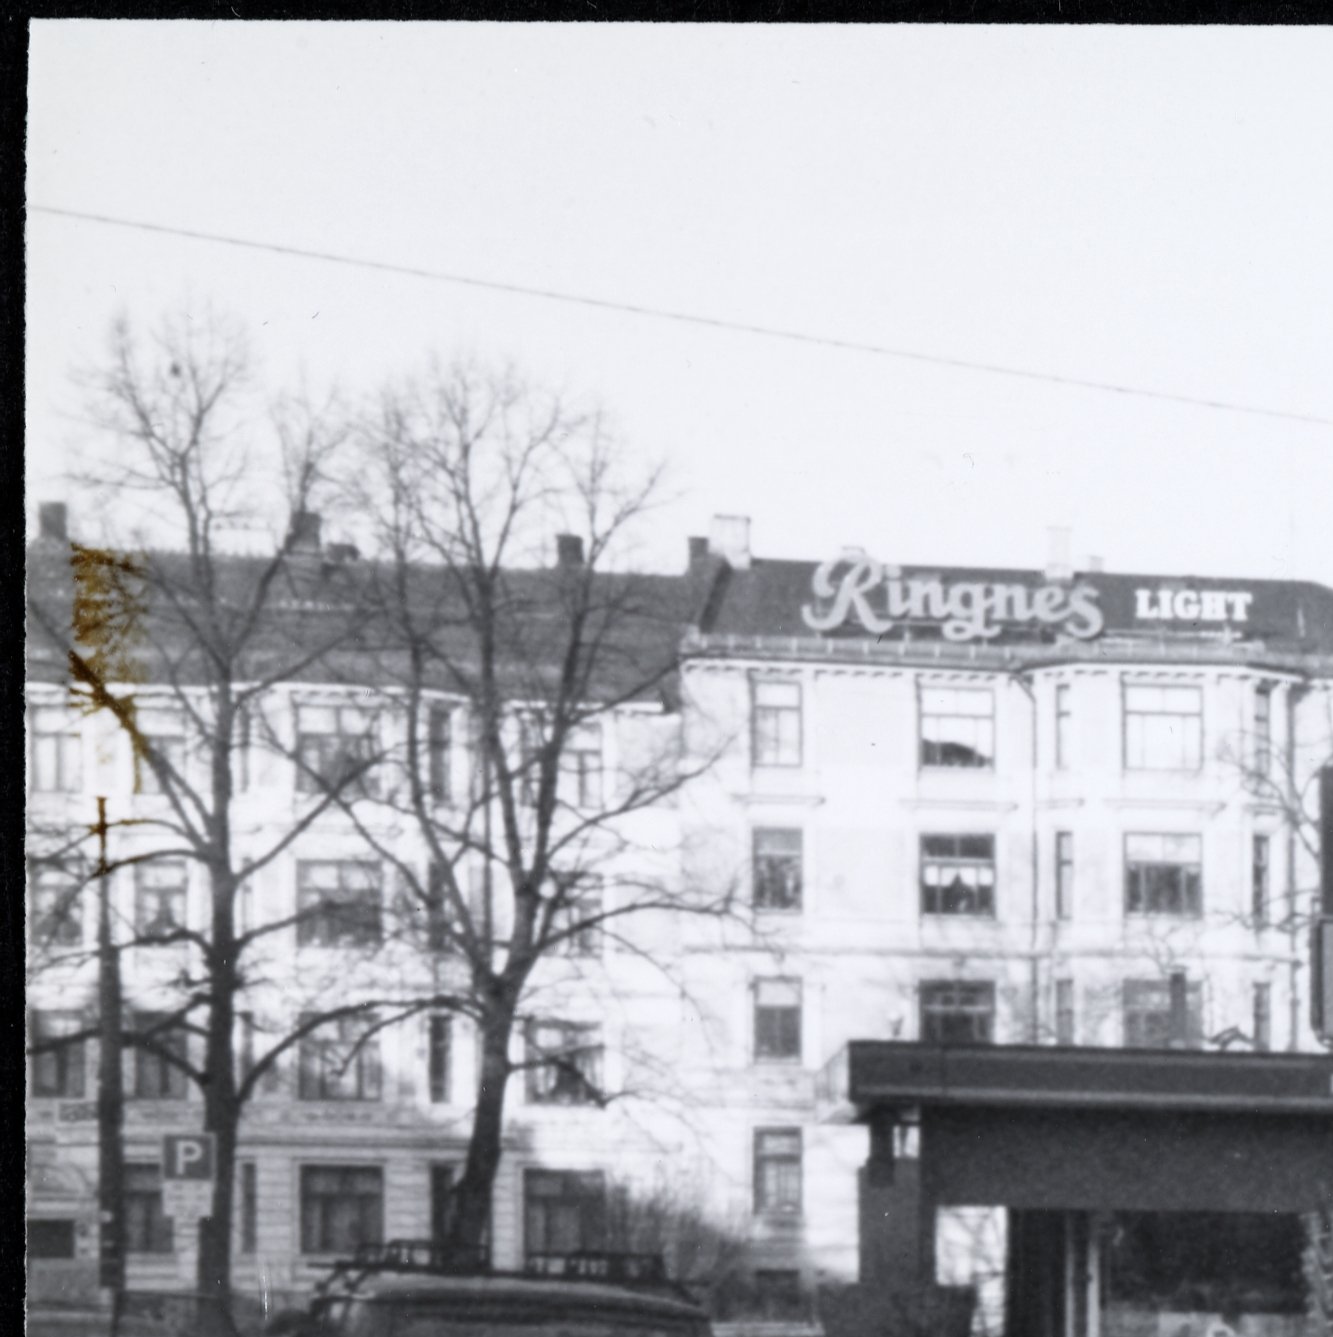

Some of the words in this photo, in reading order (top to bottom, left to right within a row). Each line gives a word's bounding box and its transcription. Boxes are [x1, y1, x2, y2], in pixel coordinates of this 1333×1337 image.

[802, 552, 1104, 643] Ringnes
[1134, 587, 1253, 622] LIGHT
[175, 1140, 203, 1176] P
